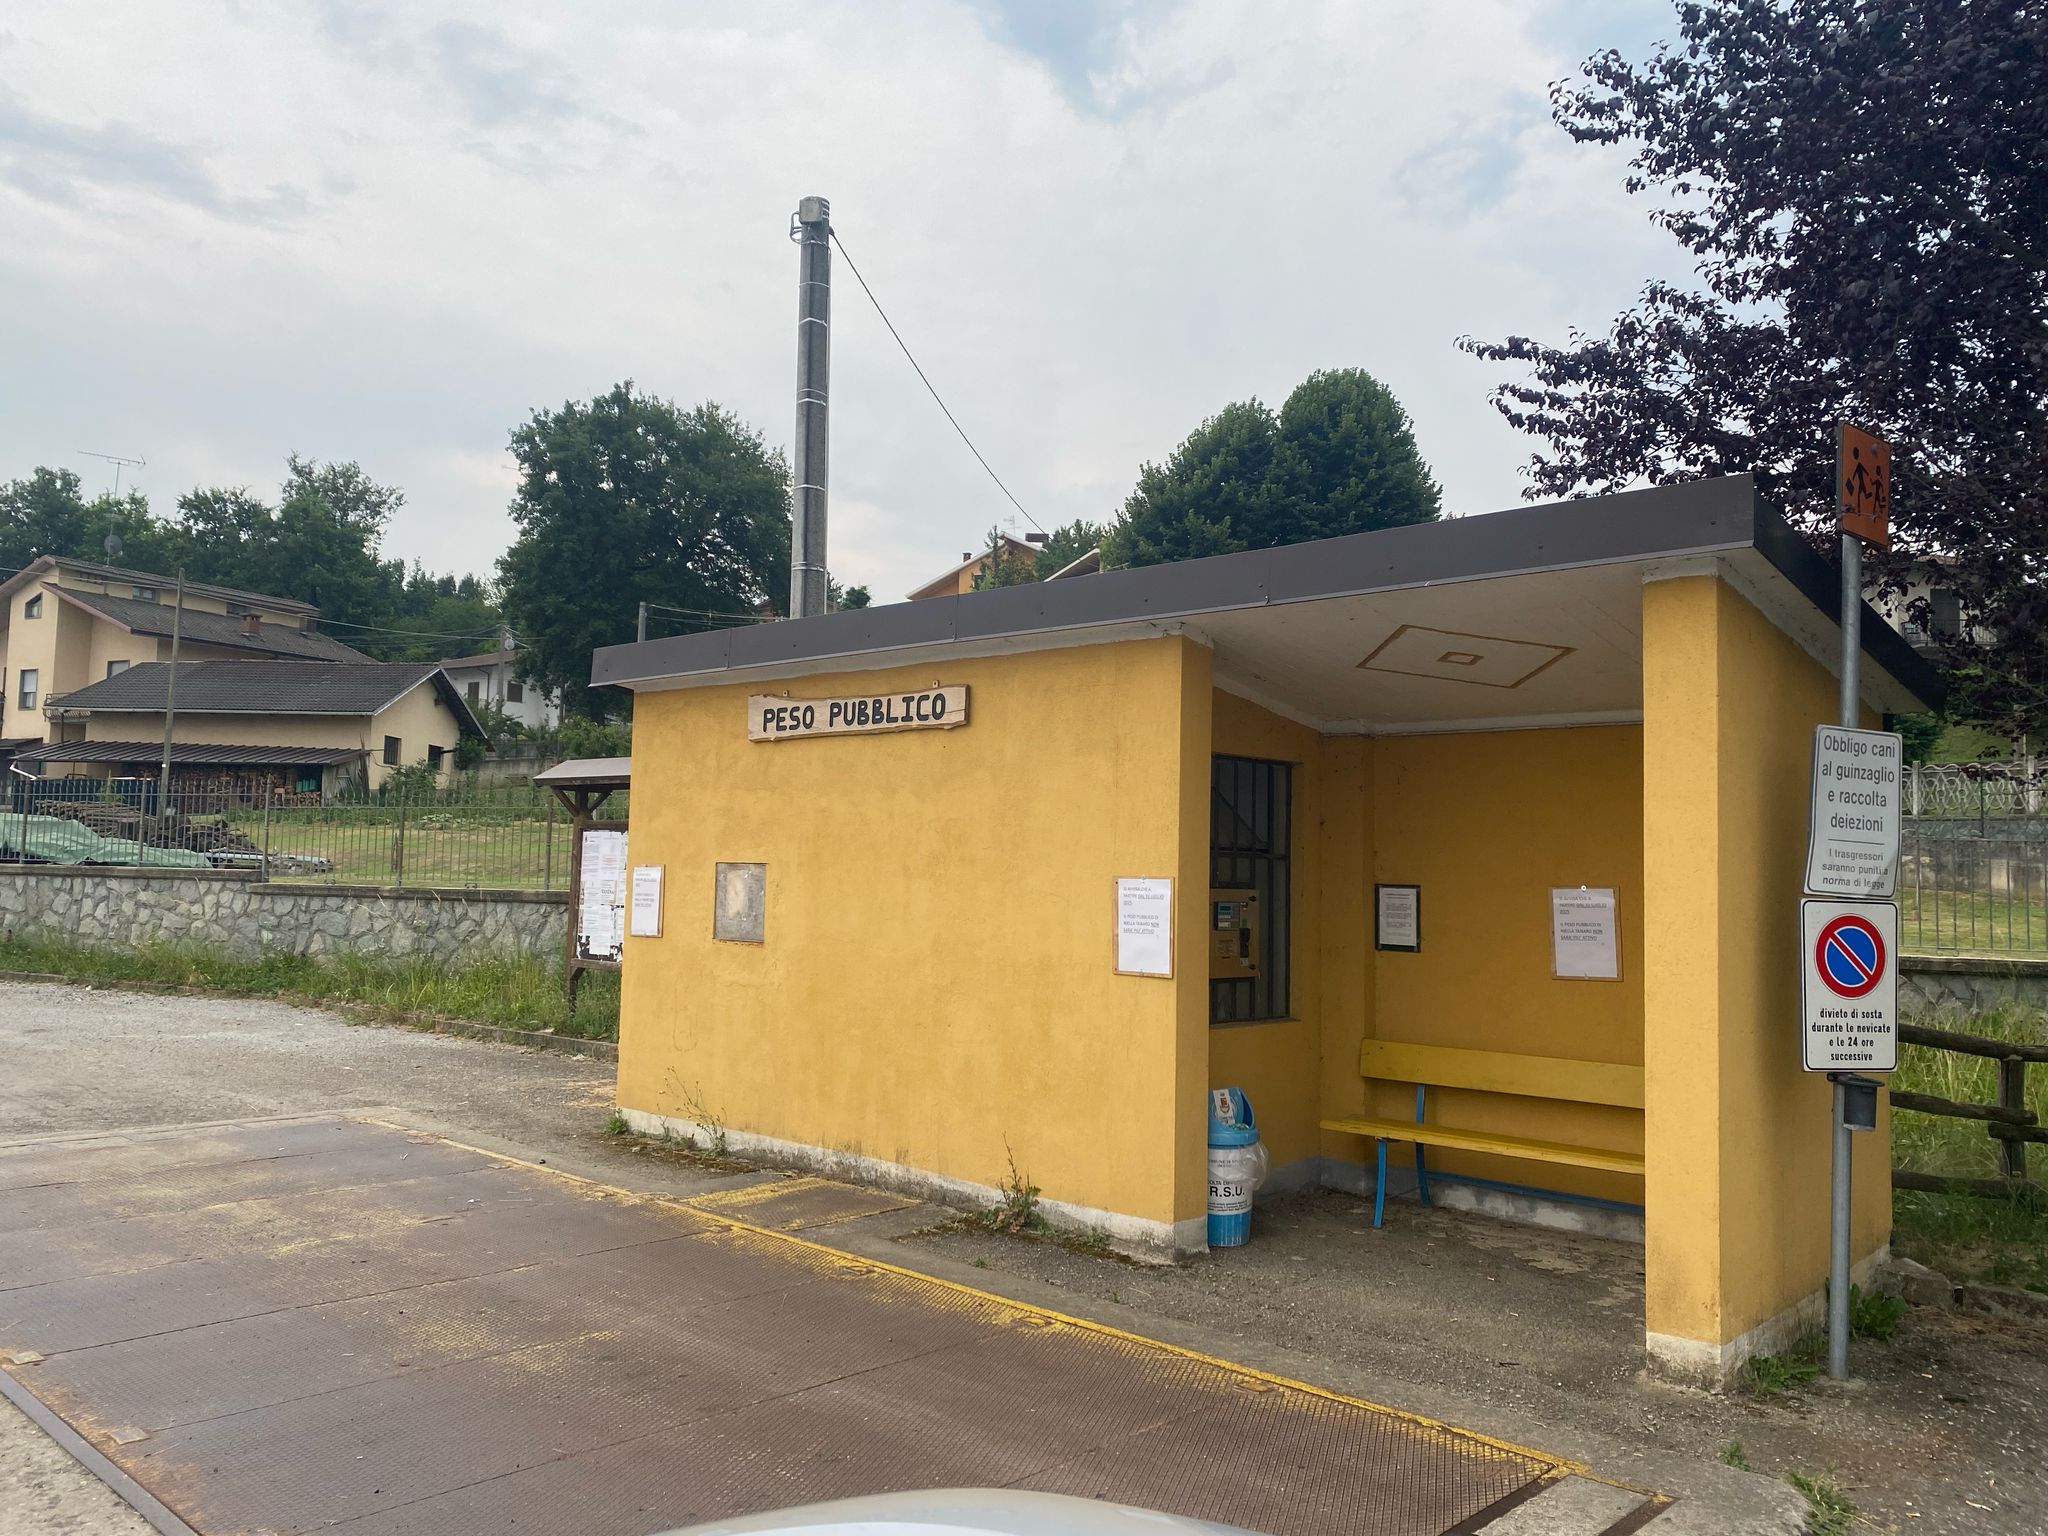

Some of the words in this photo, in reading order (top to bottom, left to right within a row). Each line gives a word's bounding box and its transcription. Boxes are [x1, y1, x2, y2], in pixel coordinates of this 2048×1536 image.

[763, 705, 815, 733] PESO
[829, 692, 946, 728] PUBBLICO
[1823, 734, 1868, 757] Obbligo
[1871, 742, 1896, 758] cani
[1822, 761, 1832, 777] al
[1836, 763, 1895, 784] guinzaglio
[1827, 790, 1835, 802] e
[1839, 790, 1887, 807] raccolta
[1830, 812, 1884, 832] deiezioni
[1834, 848, 1884, 862] trasgressori
[1822, 863, 1856, 874] saranno
[1858, 865, 1882, 876] puniti
[1822, 876, 1851, 887] norma
[1854, 877, 1862, 887] di
[1864, 878, 1885, 890] legge
[1819, 1007, 1848, 1019] divieto
[1850, 1008, 1859, 1019] di
[1861, 1009, 1883, 1019] sosta
[1811, 1022, 1843, 1033] durante
[1846, 1023, 1854, 1033] le
[1857, 1023, 1891, 1033] nevicate
[1829, 1038, 1834, 1047] e
[1836, 1037, 1845, 1047] le
[1847, 1037, 1858, 1047] 24
[1861, 1038, 1874, 1047] ore
[1830, 1050, 1873, 1061] successive
[1209, 1186, 1245, 1197] R.S.U.
